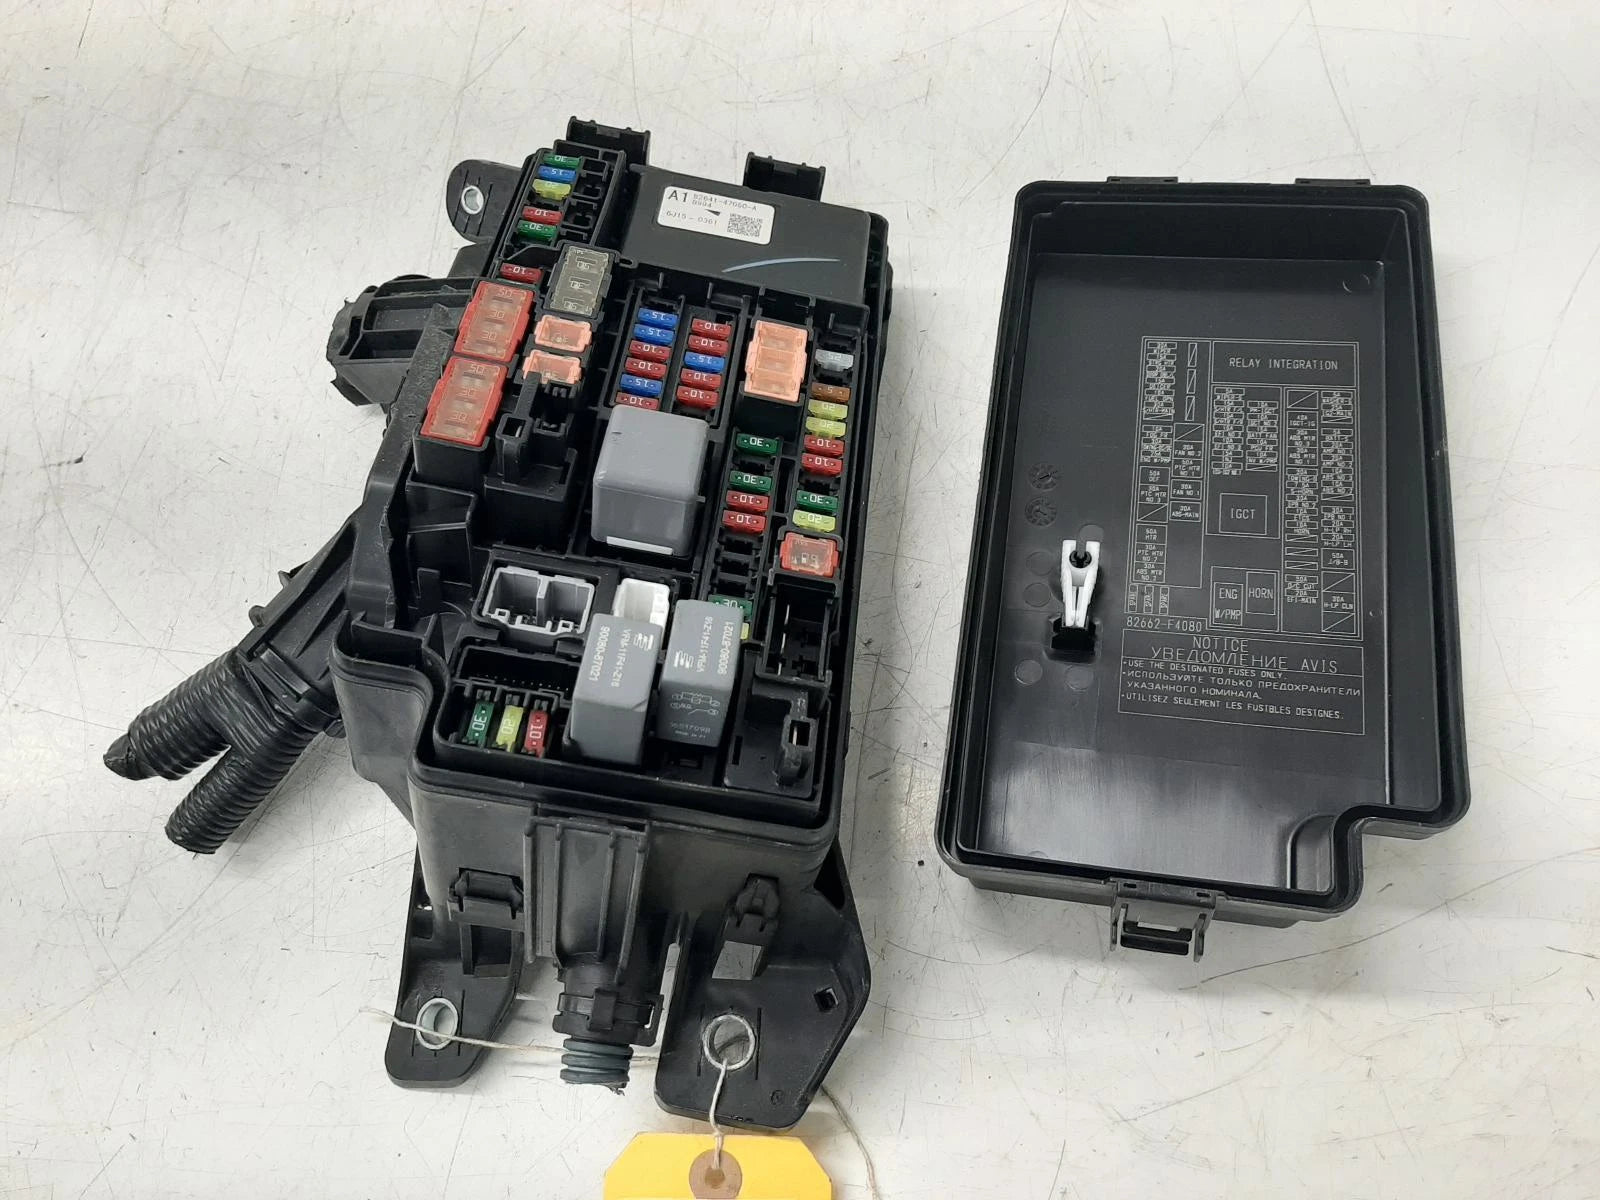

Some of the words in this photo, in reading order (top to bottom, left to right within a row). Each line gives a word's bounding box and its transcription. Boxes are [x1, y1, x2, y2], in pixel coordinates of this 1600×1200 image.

[668, 189, 688, 203] A1
[529, 222, 544, 230] 30
[513, 266, 526, 275] 10
[651, 311, 666, 320] 15
[704, 322, 718, 331] 10
[648, 328, 661, 337] 15
[643, 344, 657, 353] 10
[701, 339, 715, 348] 10
[698, 355, 712, 364] 15
[1229, 357, 1261, 368] RELAY
[1269, 358, 1338, 370] INTEGRATION
[469, 363, 485, 374] 50
[638, 362, 652, 371] 10
[693, 372, 708, 381] 10
[635, 379, 649, 388] 15
[690, 389, 704, 399] 10
[629, 396, 644, 406] 10
[749, 437, 764, 446] 30
[816, 438, 831, 448] 10
[814, 457, 829, 467] 10
[743, 474, 757, 485] 30
[739, 494, 754, 504] 10
[809, 494, 824, 504] 30
[1230, 507, 1256, 520] IGCT
[736, 514, 751, 524] 10
[1219, 587, 1238, 600] ENG
[1248, 587, 1274, 600] HORN
[1214, 607, 1241, 620] W/PMP
[1126, 616, 1202, 632] 82662-F4080
[1192, 635, 1249, 653] NOTICE
[588, 625, 611, 682] 90080-87021
[1151, 646, 1288, 670] УВЕДОМЛЕНИЕ
[1128, 659, 1145, 668] USE
[1150, 661, 1165, 670] THE
[1169, 662, 1224, 675] DESIGNATED
[1228, 667, 1256, 678] FUSES
[1260, 670, 1287, 680] ONLY.
[1300, 658, 1338, 674] AVIS
[1127, 670, 1205, 684] ИСПОЛЬЗУЙТЕ
[1210, 676, 1253, 688] ТОЛЬКО
[1258, 680, 1361, 697] ПРЕДОХРАНИТЕЛИ
[1127, 680, 1197, 694] УКАЗАННОГО
[1201, 687, 1263, 700] НОМИНАЛА.
[1126, 692, 1168, 704] UTILISEZ
[1172, 696, 1221, 708] SEULEMENT
[1225, 701, 1243, 710] LES
[1247, 703, 1291, 715] FUSIBLES
[1295, 707, 1345, 720] DESIGNES.
[471, 714, 488, 731] 30
[529, 723, 544, 740] 10
